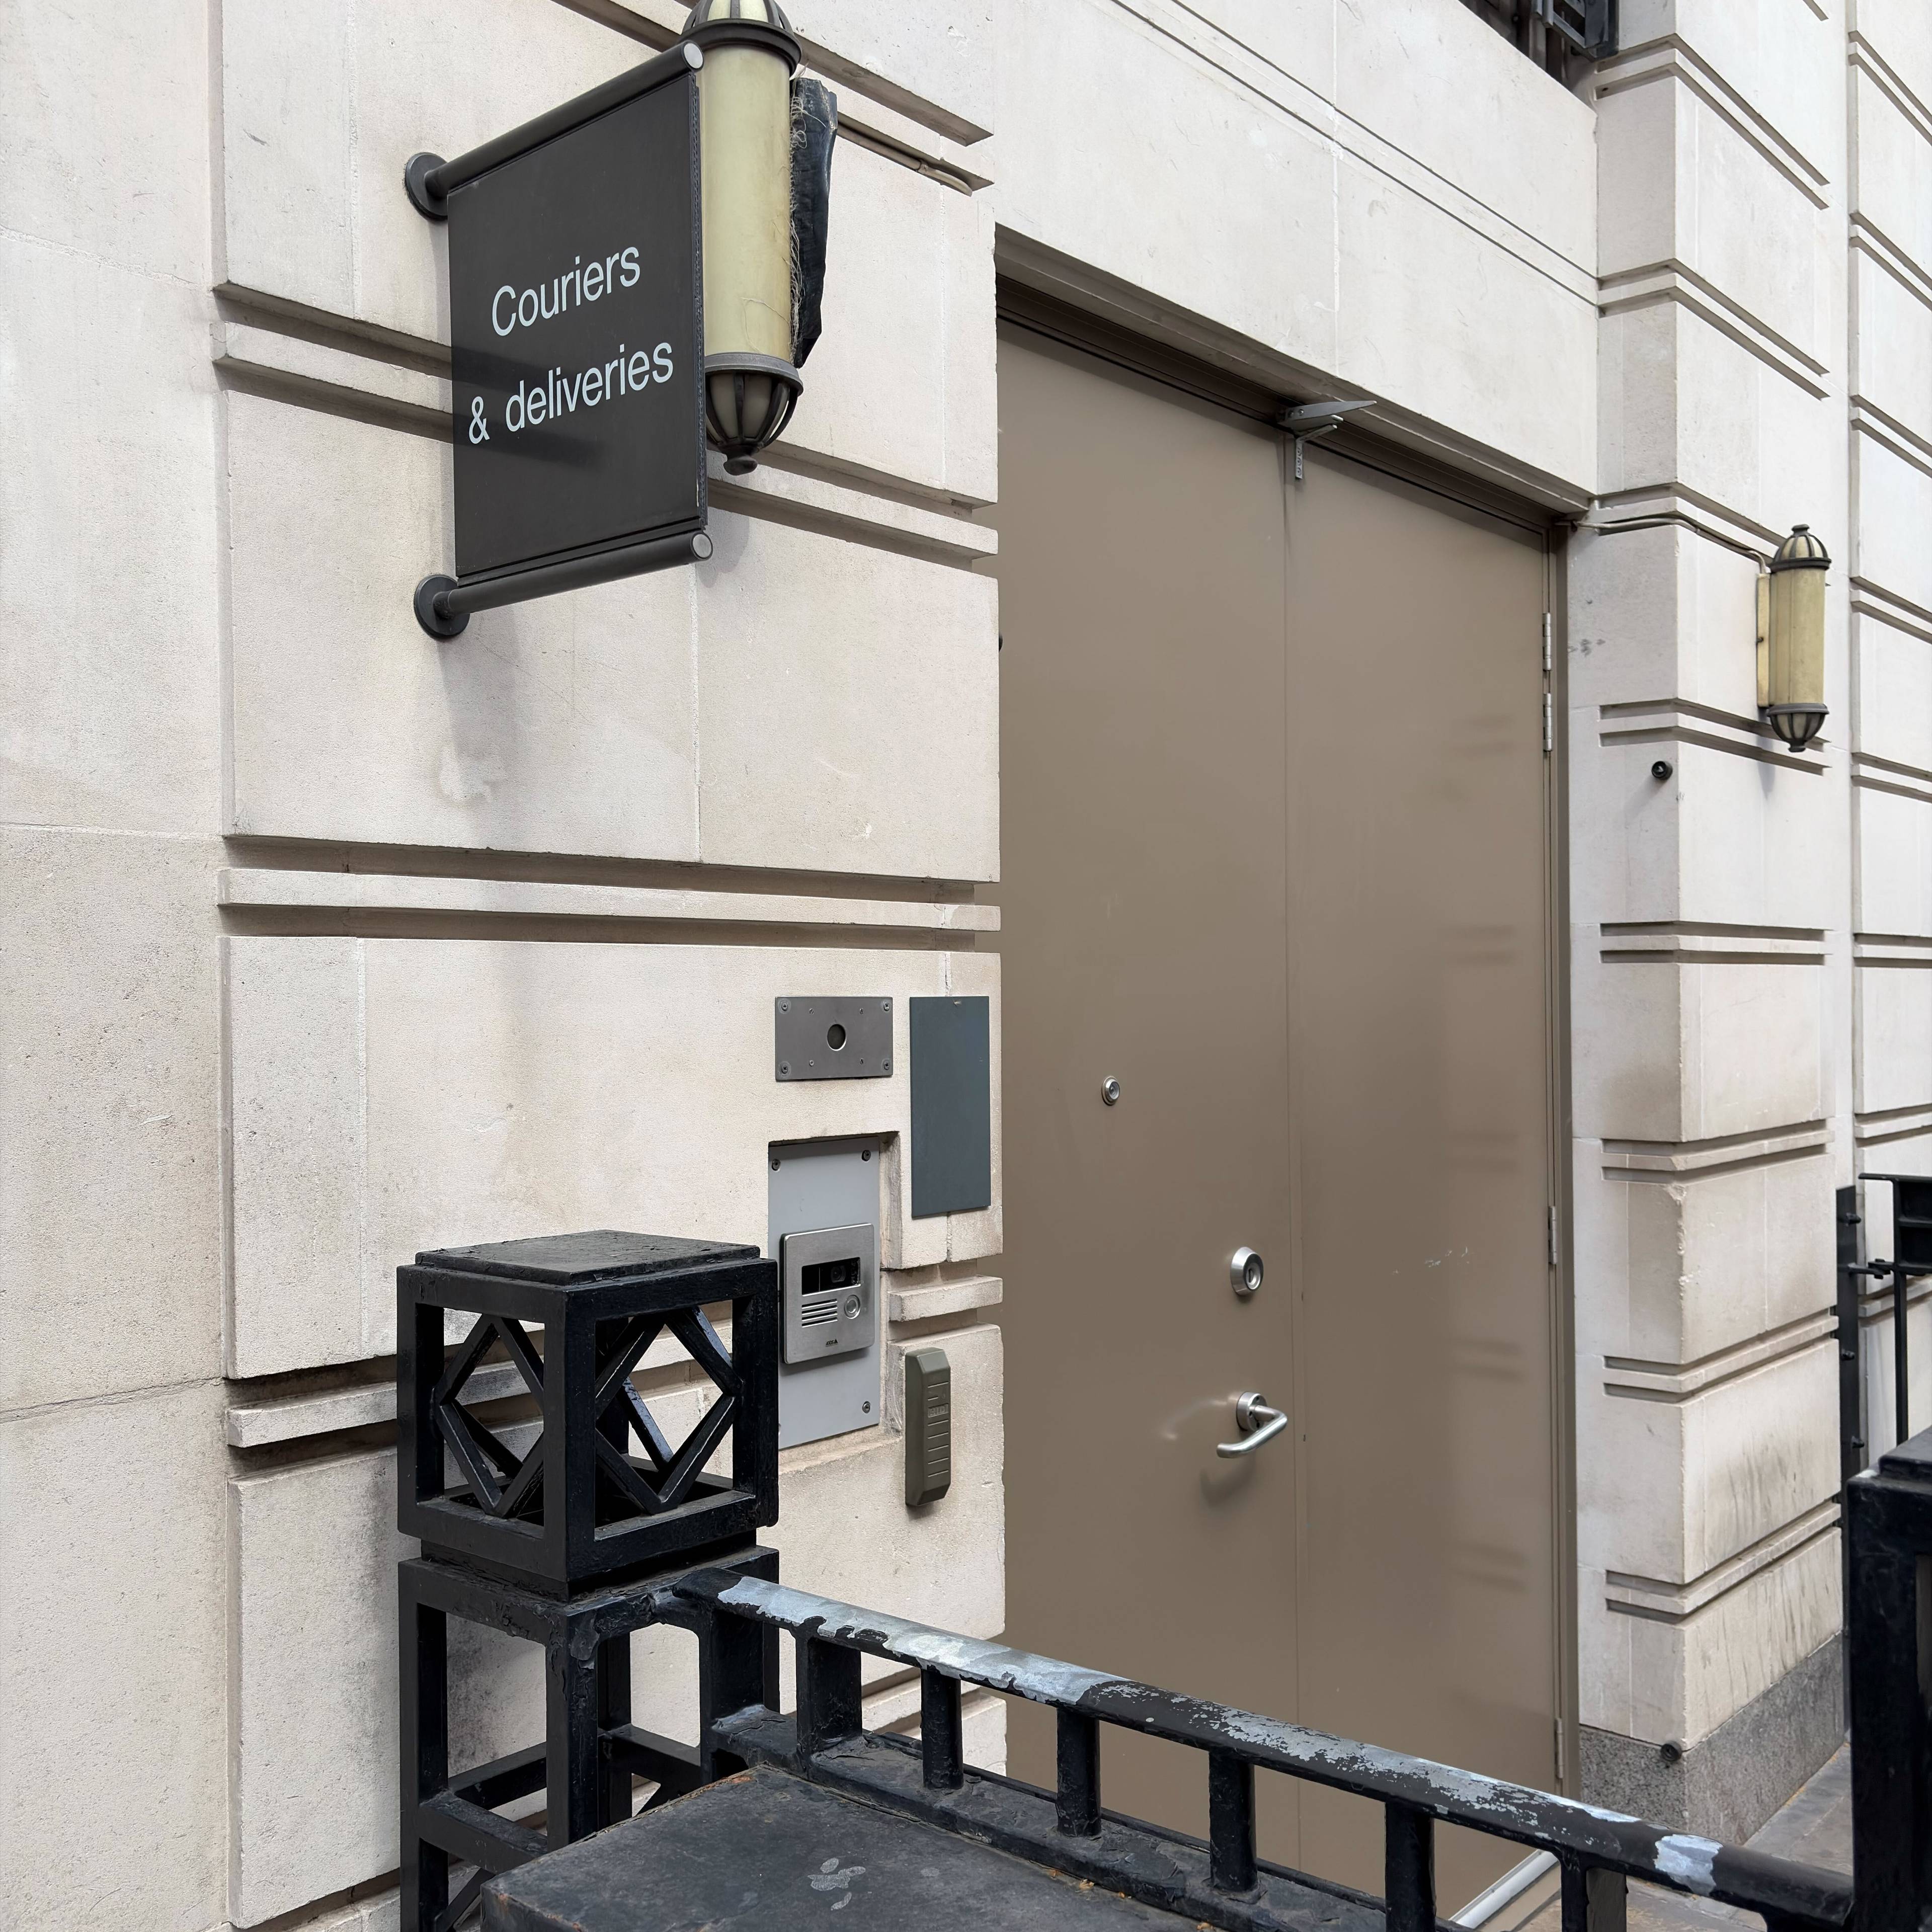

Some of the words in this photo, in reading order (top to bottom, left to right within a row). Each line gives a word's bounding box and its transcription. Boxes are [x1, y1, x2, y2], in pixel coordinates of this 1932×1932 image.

[492, 247, 640, 336] Couriers
[469, 396, 490, 444] &
[506, 342, 673, 432] deliveries
